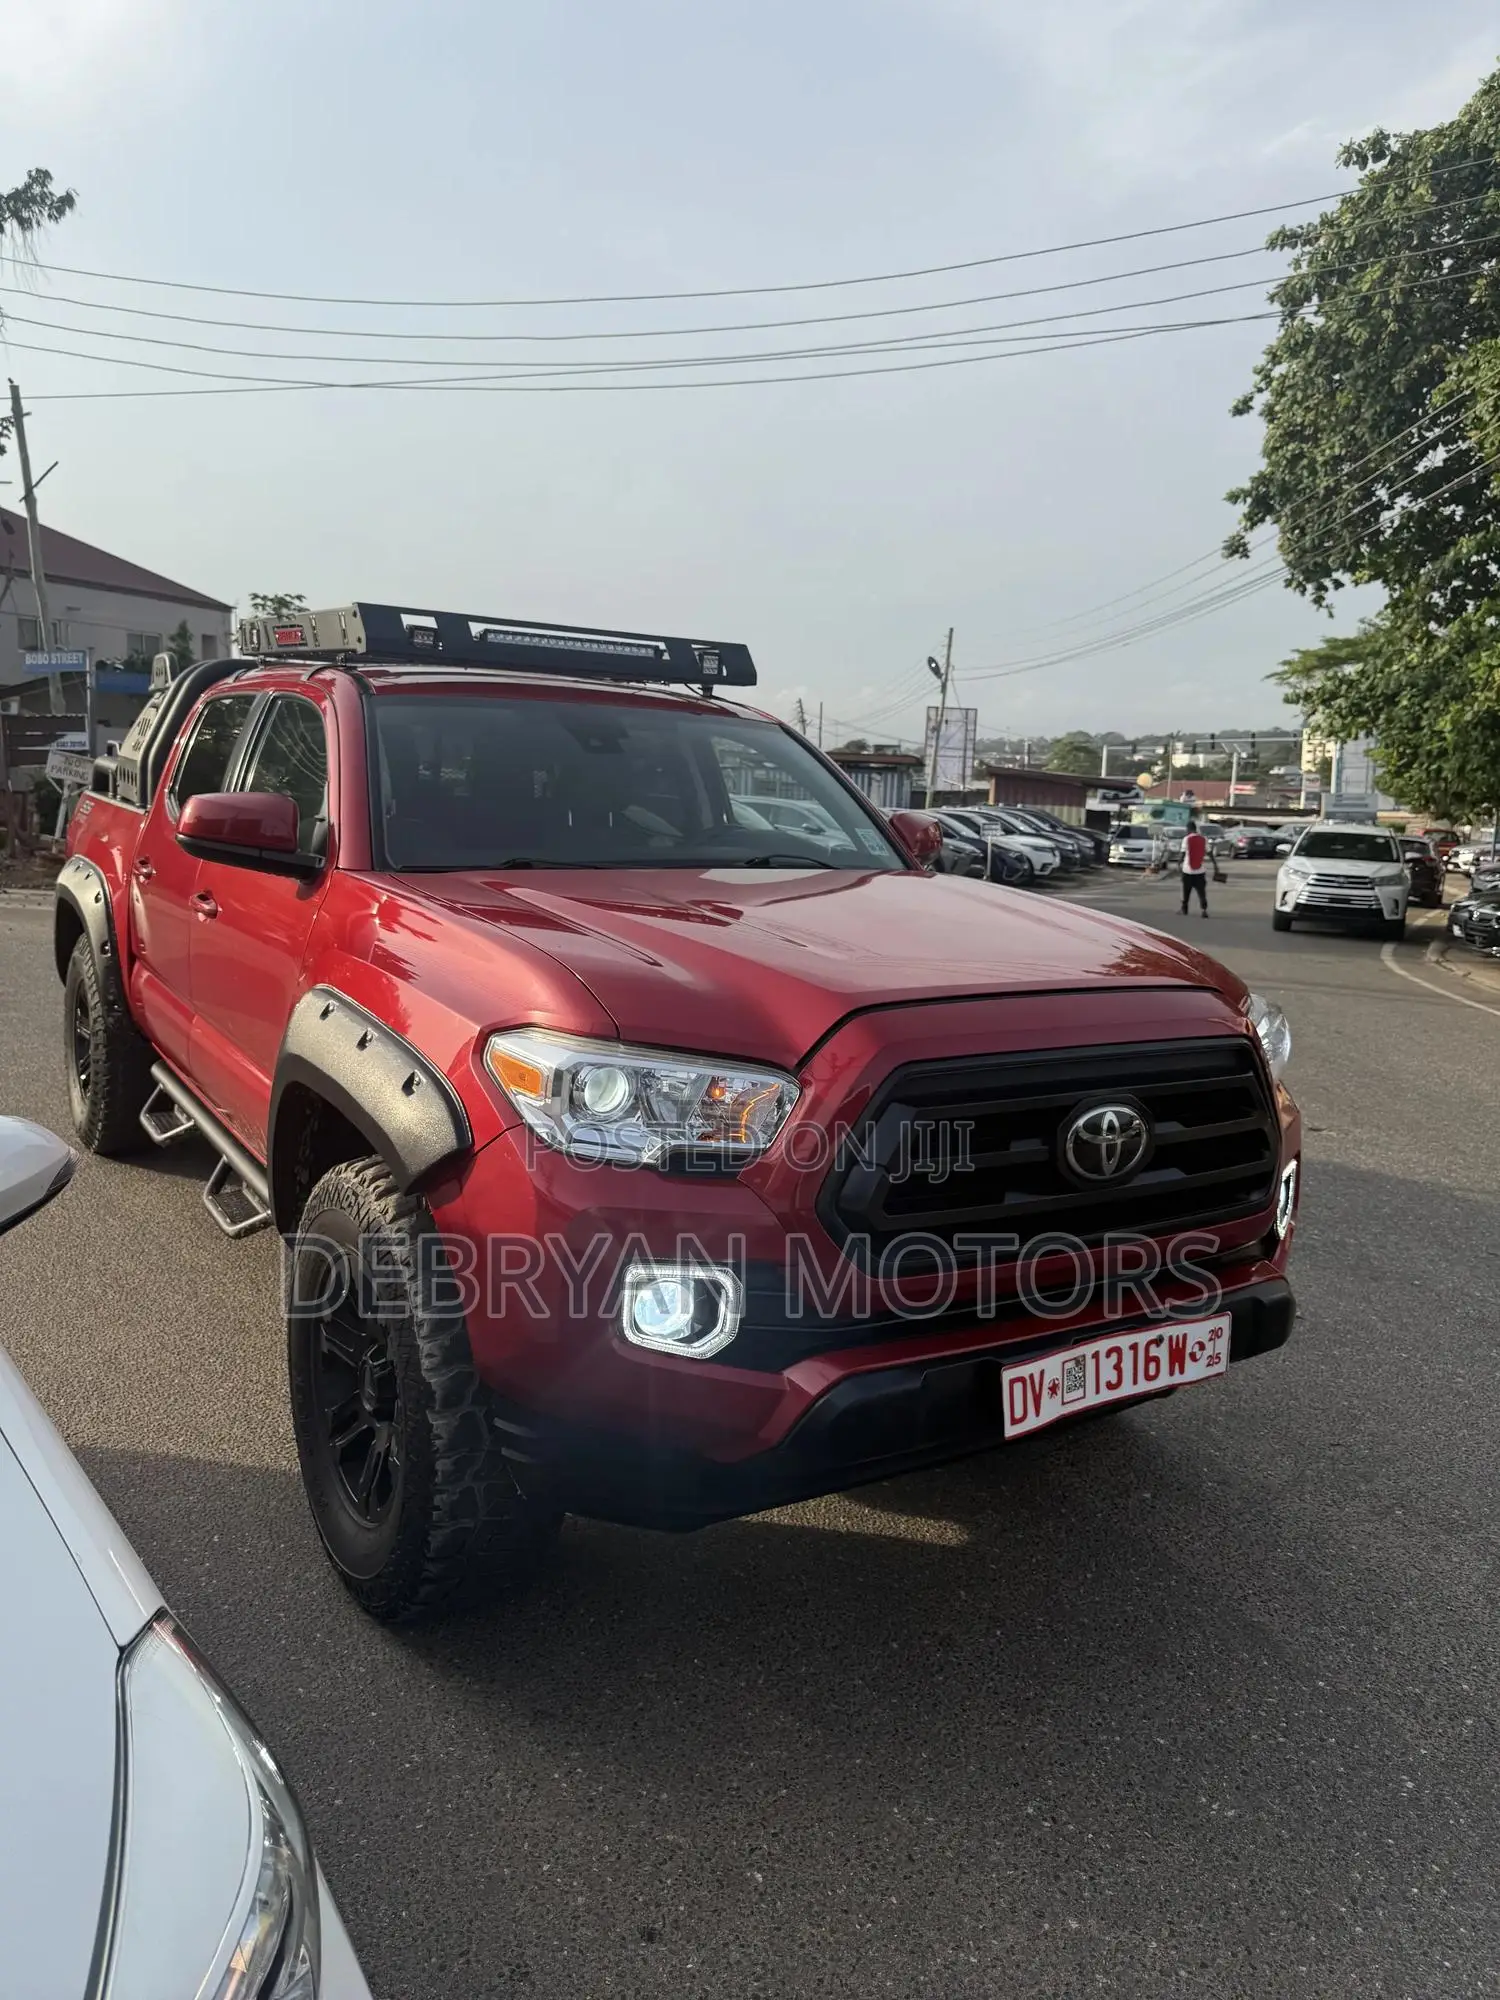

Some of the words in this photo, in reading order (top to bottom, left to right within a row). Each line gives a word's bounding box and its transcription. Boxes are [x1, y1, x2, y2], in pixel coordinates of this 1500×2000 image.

[50, 651, 84, 665] STREET
[50, 764, 90, 781] PARKING
[1008, 1368, 1045, 1426] DV
